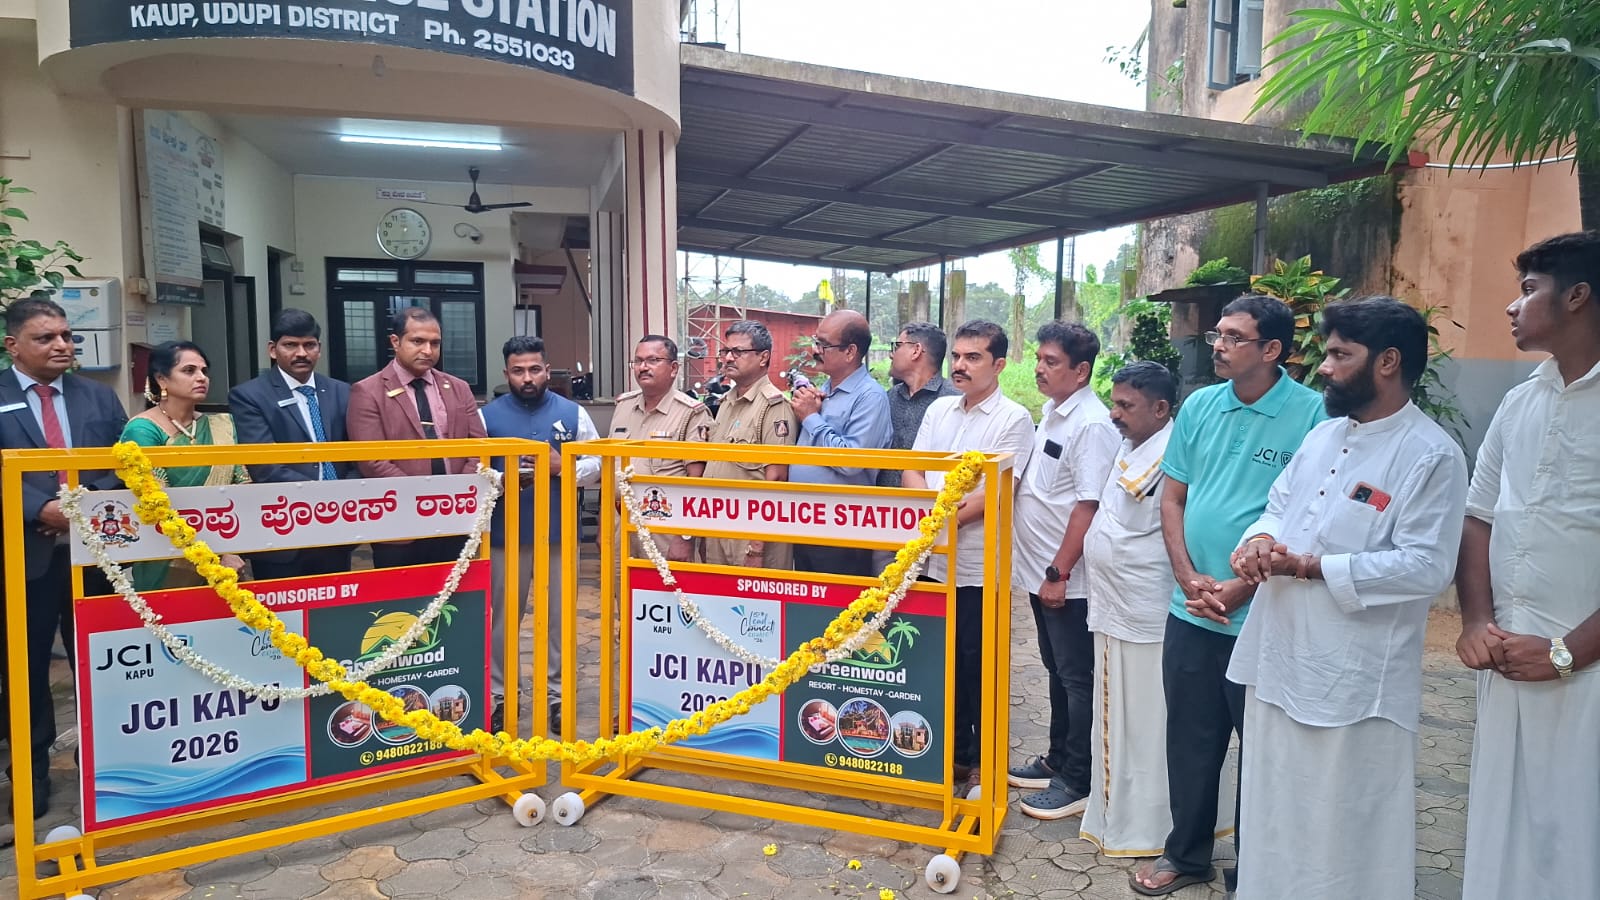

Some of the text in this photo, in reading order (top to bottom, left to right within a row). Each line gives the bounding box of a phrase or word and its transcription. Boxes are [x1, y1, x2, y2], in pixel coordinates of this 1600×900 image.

[131, 2, 575, 71] KAUP, UDUPI DISTRICT Ph. 2551033
[1254, 447, 1278, 462] JCI
[155, 485, 477, 539] ಾಪು ಪೊಲೀಸ್ ಠಾಣೆ
[682, 497, 739, 519] KAPU
[748, 502, 826, 525] POLICE
[256, 584, 359, 606] PONSORED BY
[737, 578, 827, 598] SPONSORED BY
[635, 604, 671, 623] JCI
[653, 625, 672, 634] KAPU
[96, 643, 152, 671] JCI
[125, 668, 154, 680] KAPU
[378, 673, 422, 686] HOMESTAY
[649, 654, 762, 686] JCI KAPU
[808, 680, 836, 691] RESORT
[842, 685, 884, 697] HOMESTAY
[681, 692, 727, 713] 20
[121, 698, 178, 734] JCI
[171, 731, 239, 763] 2026
[376, 740, 442, 761] 9480822188
[839, 755, 903, 775] 9480822188
